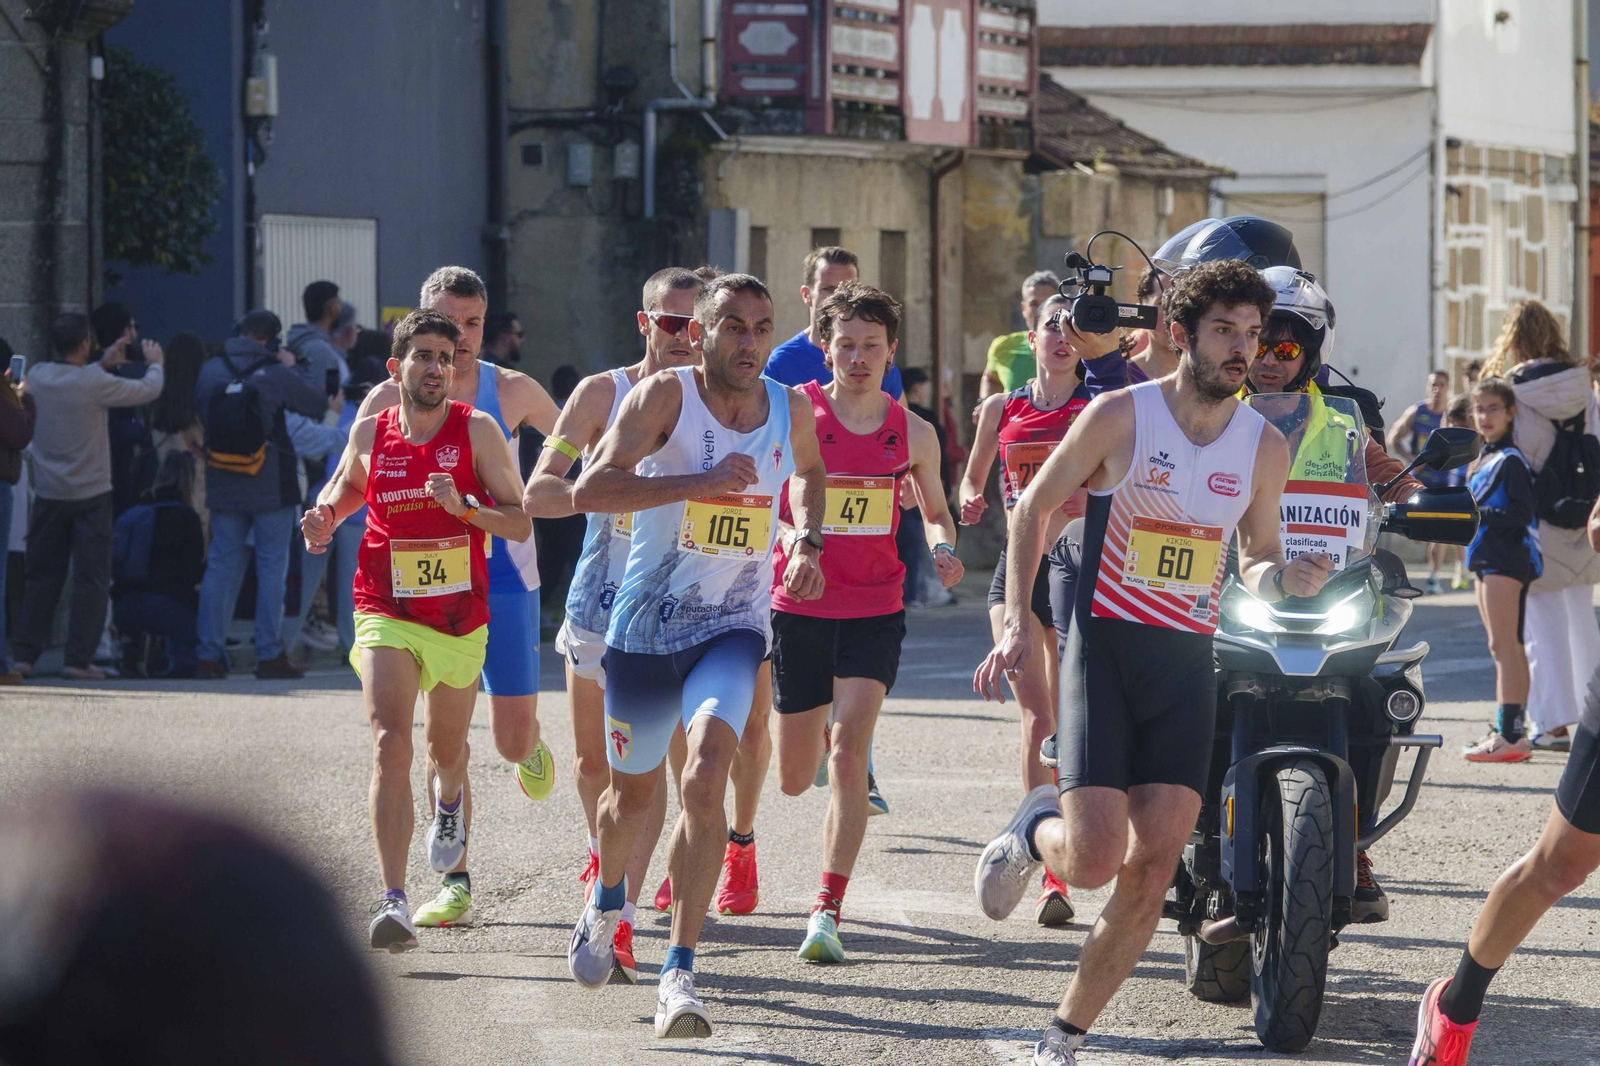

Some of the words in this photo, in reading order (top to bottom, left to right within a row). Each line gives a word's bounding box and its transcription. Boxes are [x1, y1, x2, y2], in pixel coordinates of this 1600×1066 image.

[1149, 456, 1176, 470] amura
[376, 493, 382, 504] A
[386, 499, 424, 519] paraíso
[722, 507, 742, 515] JORDI
[840, 497, 869, 524] 47
[707, 514, 751, 547] 105
[1166, 537, 1192, 546] KIKIÑO
[1285, 537, 1328, 548] clasificada
[1157, 545, 1194, 580] 60
[417, 559, 447, 586] 34
